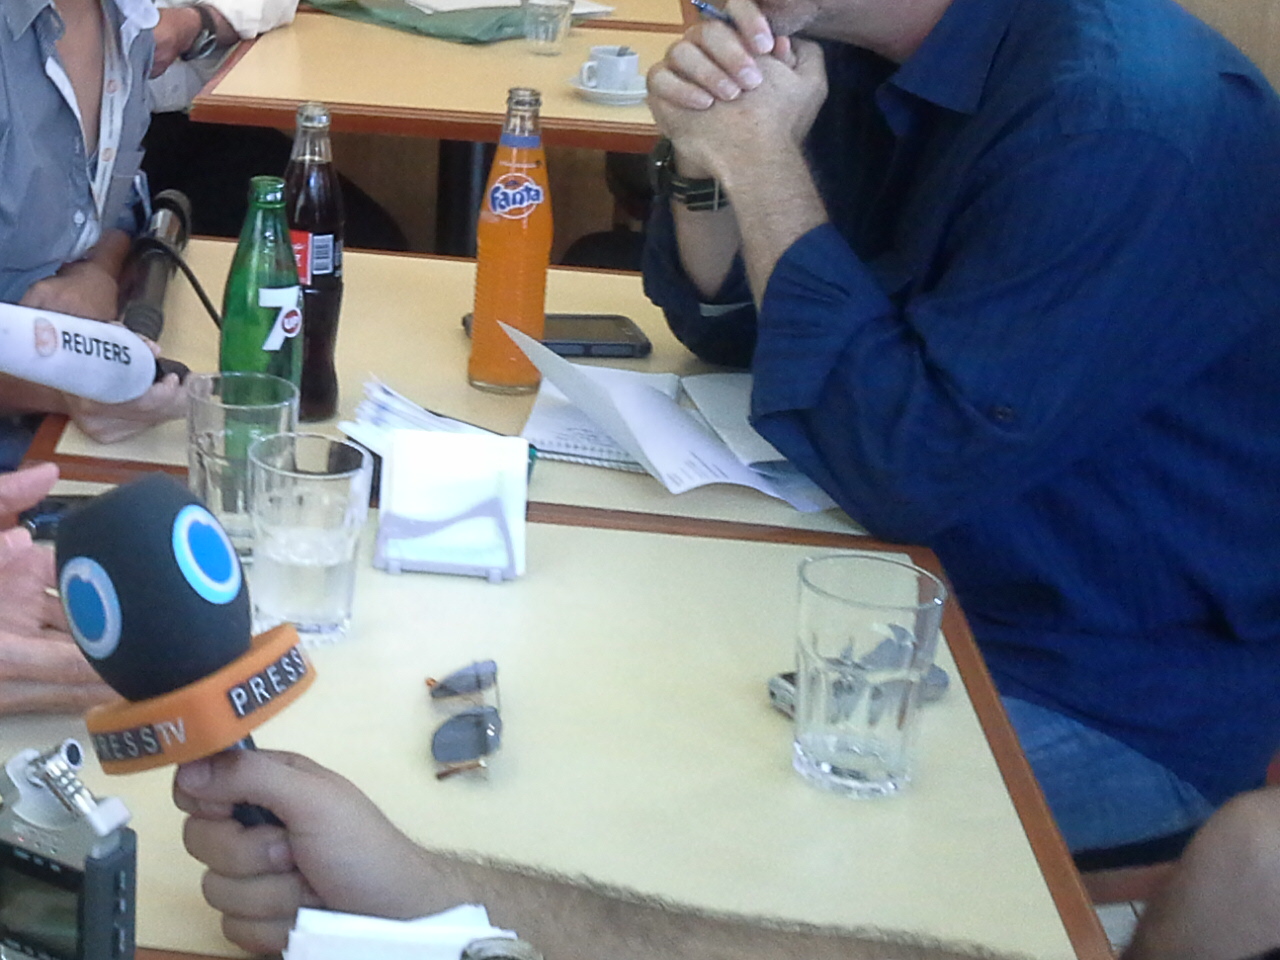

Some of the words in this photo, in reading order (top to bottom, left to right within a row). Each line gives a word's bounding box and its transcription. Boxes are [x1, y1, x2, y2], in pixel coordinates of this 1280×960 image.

[489, 184, 542, 213] Fanta
[61, 330, 132, 365] REUTERS
[229, 648, 306, 716] PRESS
